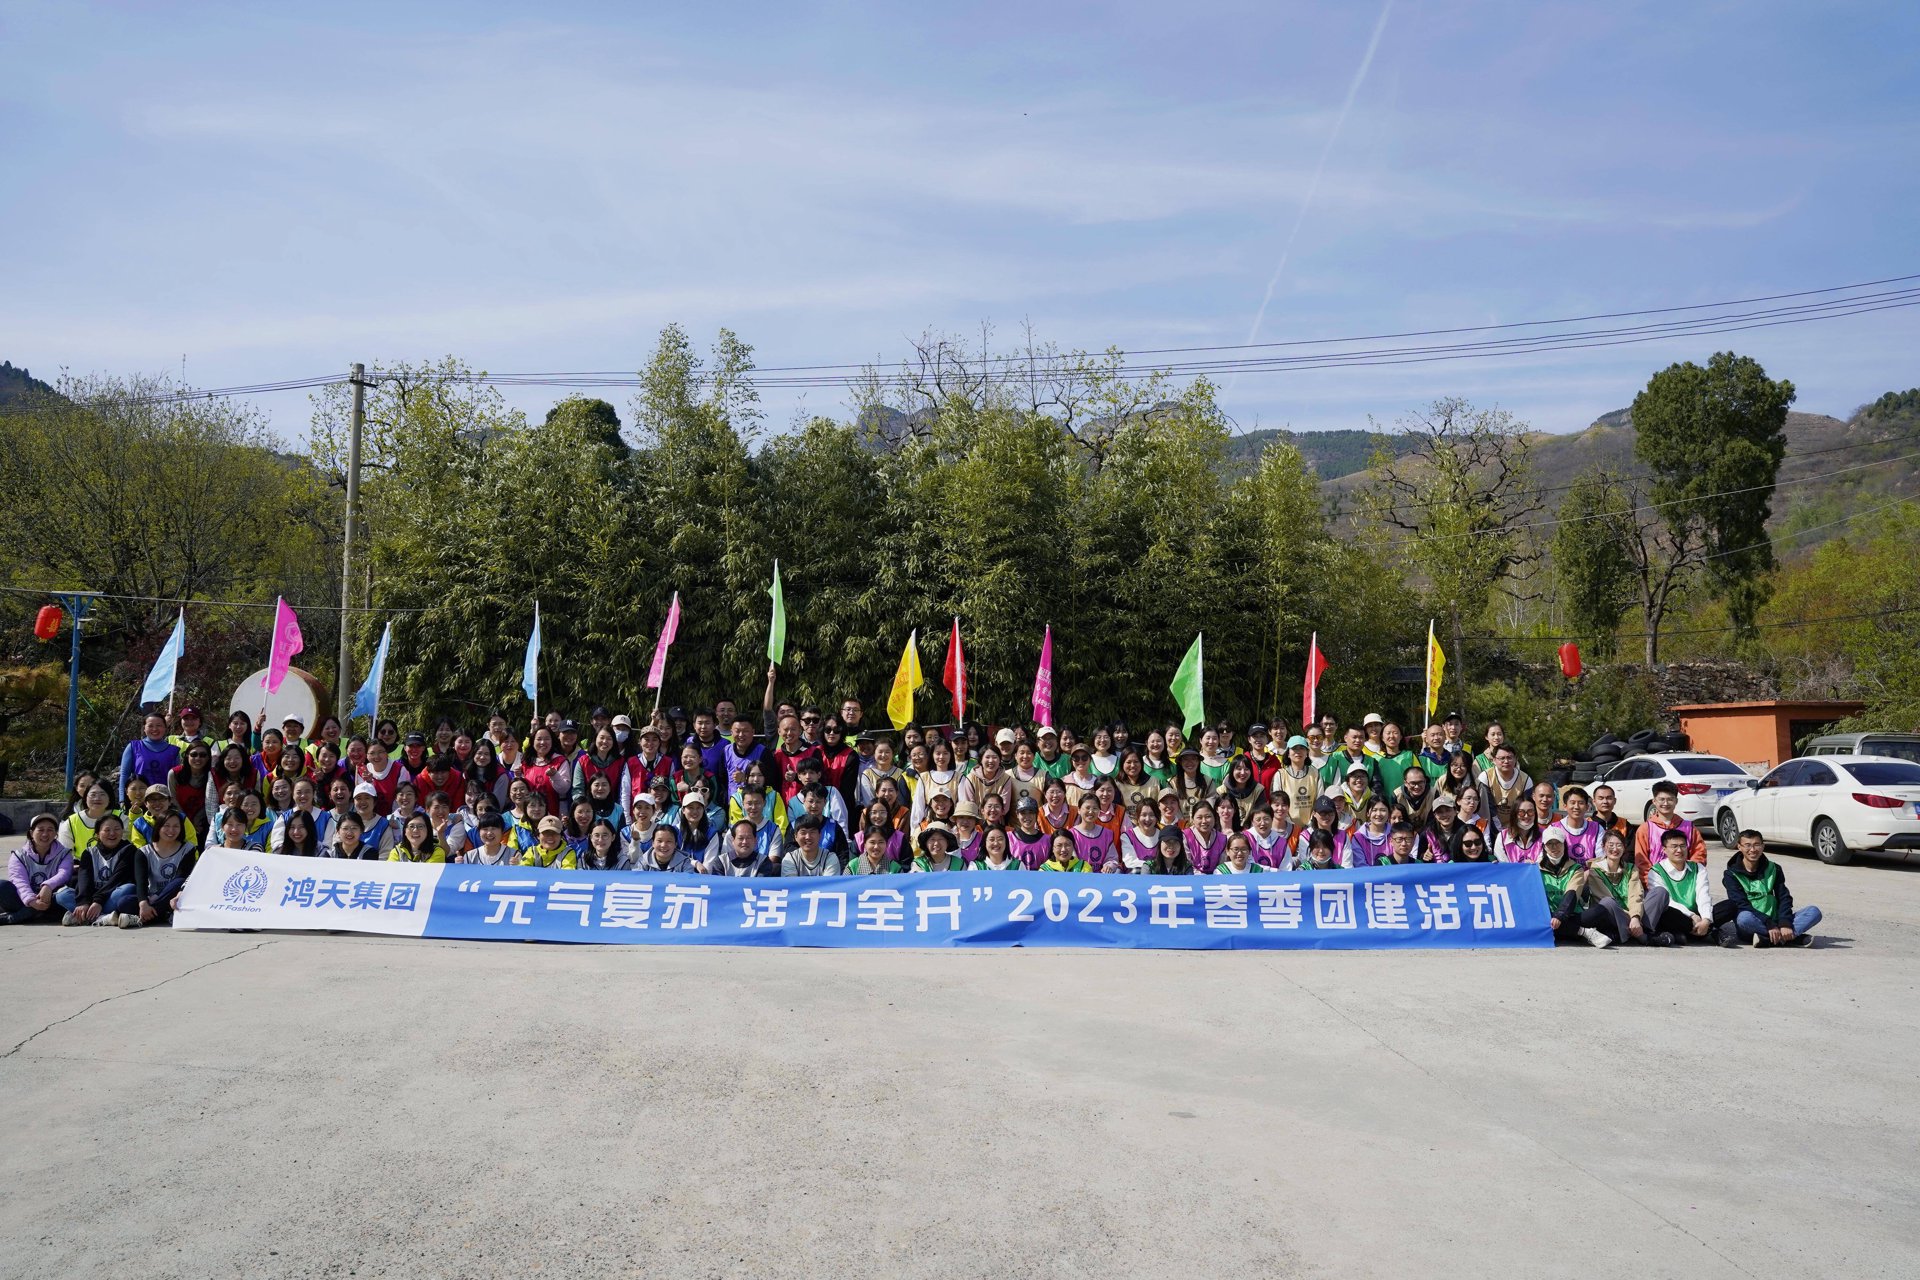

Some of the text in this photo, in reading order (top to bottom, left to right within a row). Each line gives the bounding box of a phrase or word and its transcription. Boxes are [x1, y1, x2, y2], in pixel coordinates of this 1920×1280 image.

[280, 876, 421, 912] 鸿天集团
[225, 904, 262, 913] Fashion
